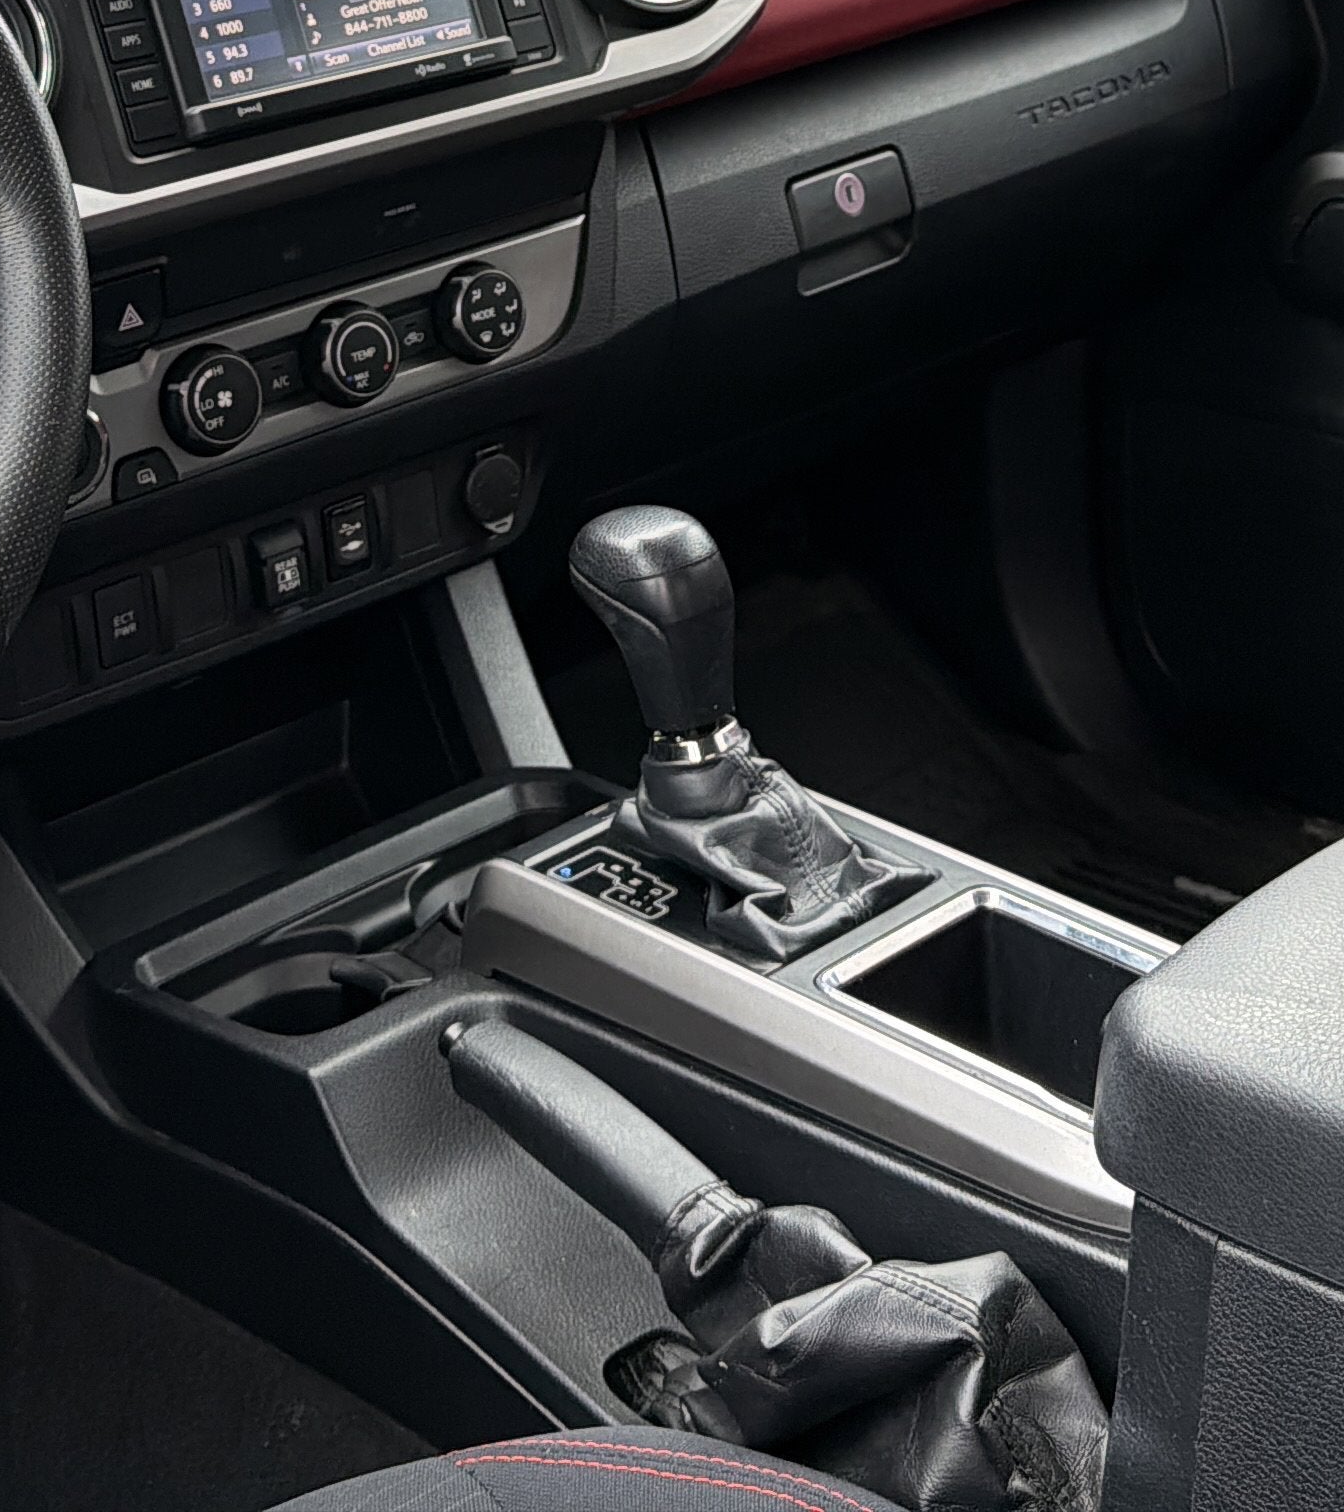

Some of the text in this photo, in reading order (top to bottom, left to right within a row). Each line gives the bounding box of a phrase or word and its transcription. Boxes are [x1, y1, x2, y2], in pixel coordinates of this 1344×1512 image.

[192, 2, 203, 17] 3
[340, 3, 369, 19] Great
[199, 19, 244, 41] 4 1000
[344, 7, 428, 37] 844-711-8800
[445, 24, 471, 40] Sound
[121, 34, 142, 48] APPS
[367, 34, 426, 58] Channel List
[205, 43, 249, 64] 5 94.3
[324, 53, 350, 67] Scan
[131, 78, 155, 93] HOME
[213, 67, 254, 88] 6 89.7
[1015, 58, 1172, 127] TACOMA
[470, 306, 497, 323] MODE
[350, 346, 377, 363] TEMP
[211, 364, 225, 377] HI
[272, 375, 291, 389] A/C
[200, 397, 215, 412] LO
[205, 415, 225, 431] OFF
[274, 556, 299, 572] REAR
[278, 577, 302, 594] PUSH
[112, 610, 135, 628] ECT
[113, 621, 137, 639] PWR
